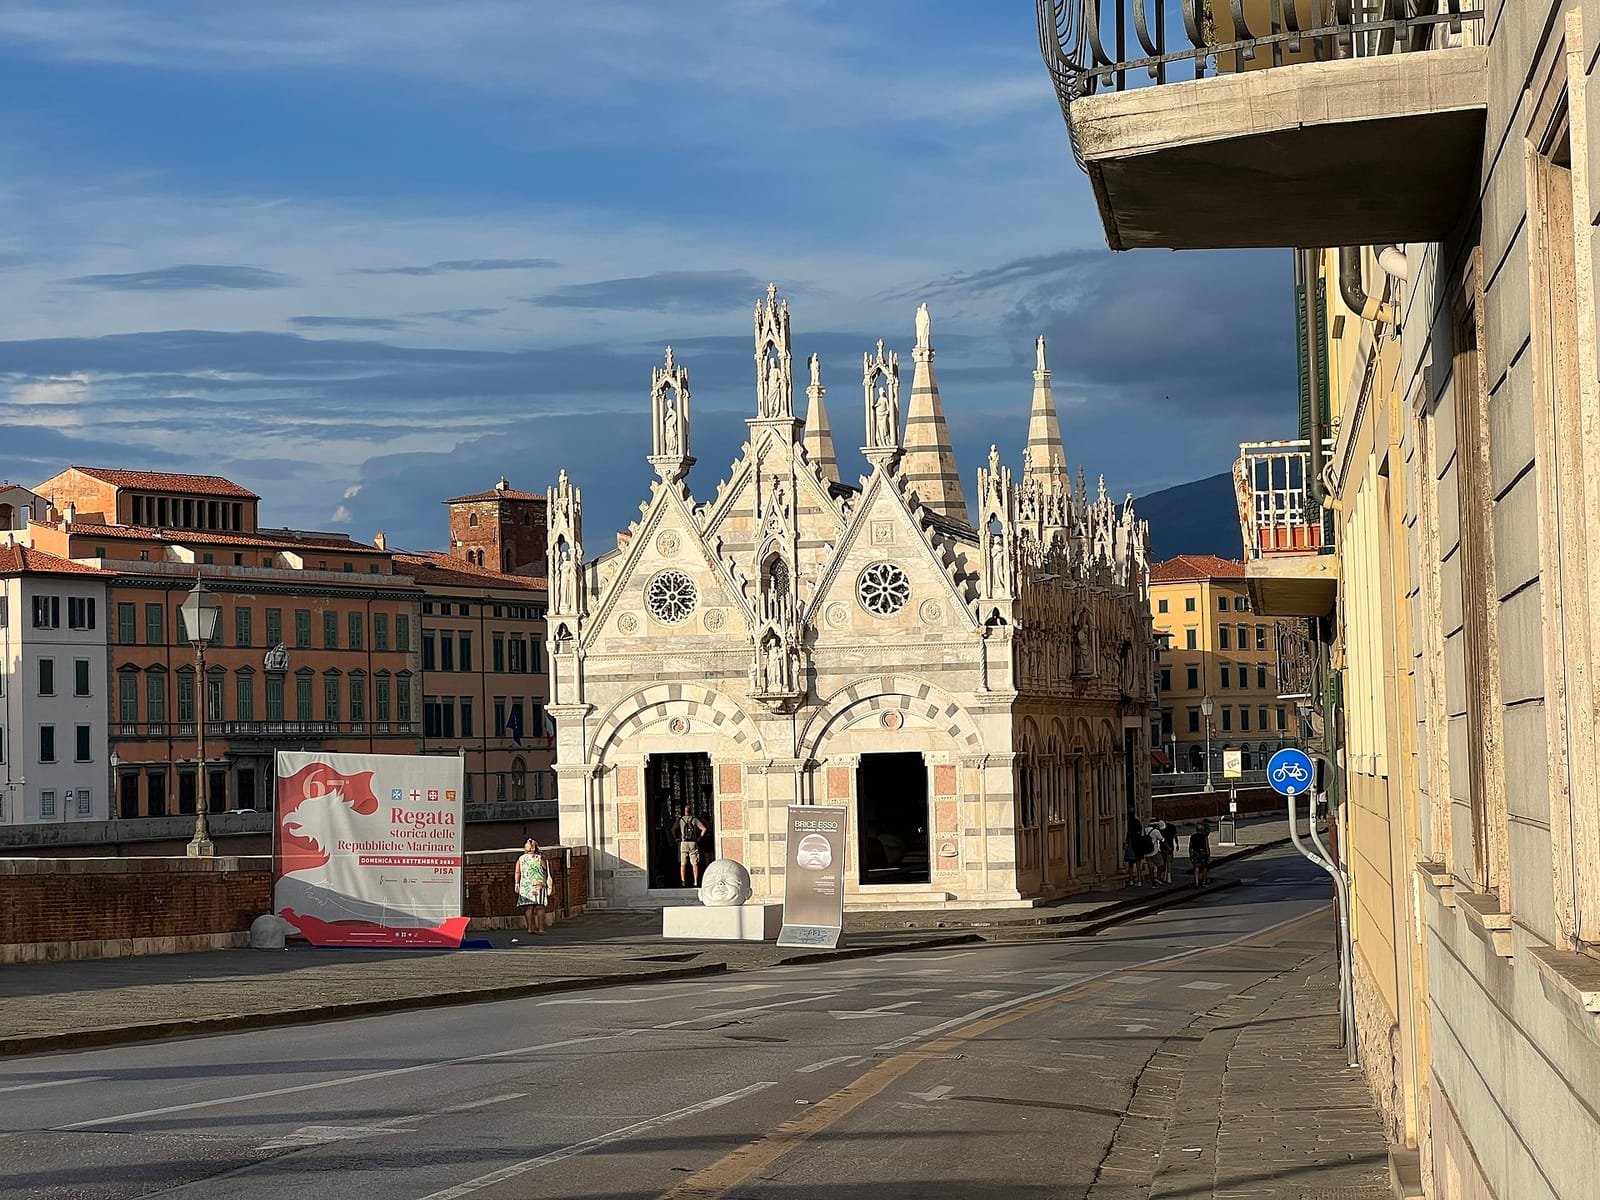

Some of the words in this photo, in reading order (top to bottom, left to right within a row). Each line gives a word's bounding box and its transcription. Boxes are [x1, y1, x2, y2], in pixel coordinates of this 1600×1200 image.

[391, 807, 455, 828] Regata
[794, 820, 817, 828] BRICE
[818, 821, 838, 829] ESSO
[390, 828, 427, 839] storica
[429, 829, 455, 839] delle
[338, 840, 404, 852] Repubbliche
[407, 842, 455, 852] Marinare
[433, 867, 454, 875] PISA
